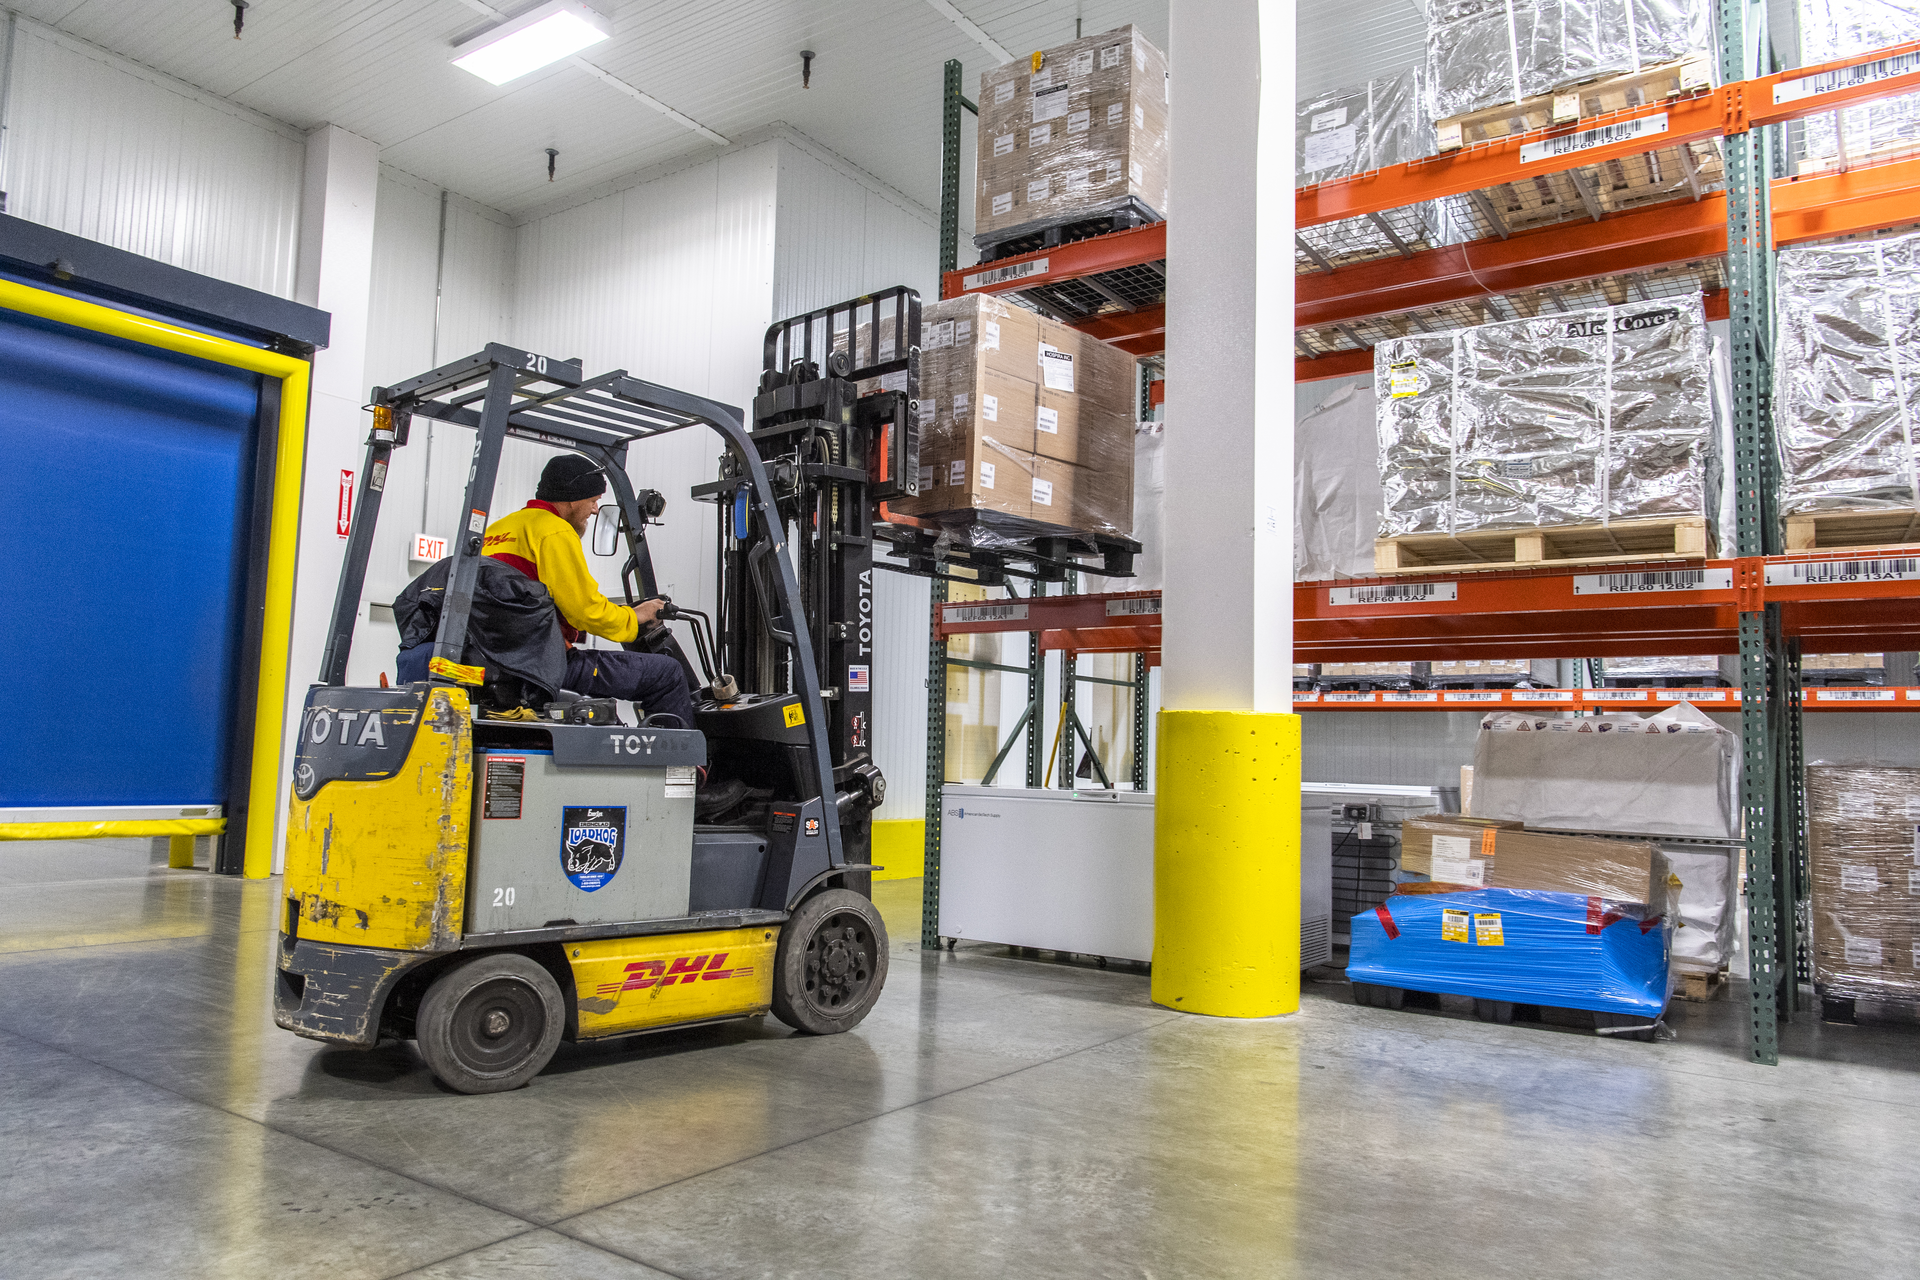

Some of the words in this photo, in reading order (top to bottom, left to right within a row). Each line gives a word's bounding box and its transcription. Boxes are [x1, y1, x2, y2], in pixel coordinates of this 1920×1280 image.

[1815, 77, 1865, 93] REF60
[1872, 66, 1910, 80] 13C1
[1553, 141, 1595, 155] REF60
[1600, 132, 1632, 144] 12C2
[983, 276, 1007, 286] REF60
[1009, 271, 1028, 280] 12C1
[526, 353, 548, 374] 20
[1046, 351, 1063, 360] HOSPIRA
[469, 439, 482, 483] 20
[418, 538, 444, 560] EXIT
[1609, 584, 1654, 592] REF60
[1658, 582, 1694, 590] 12B2
[1806, 574, 1858, 583] REF60
[1863, 572, 1903, 580] 13A1
[859, 569, 872, 657] TOYOTA
[947, 809, 959, 817] ABS
[805, 819, 819, 830] SAS
[569, 828, 617, 847] LOADHOG
[492, 886, 516, 907] 20
[620, 952, 736, 992] DHL
